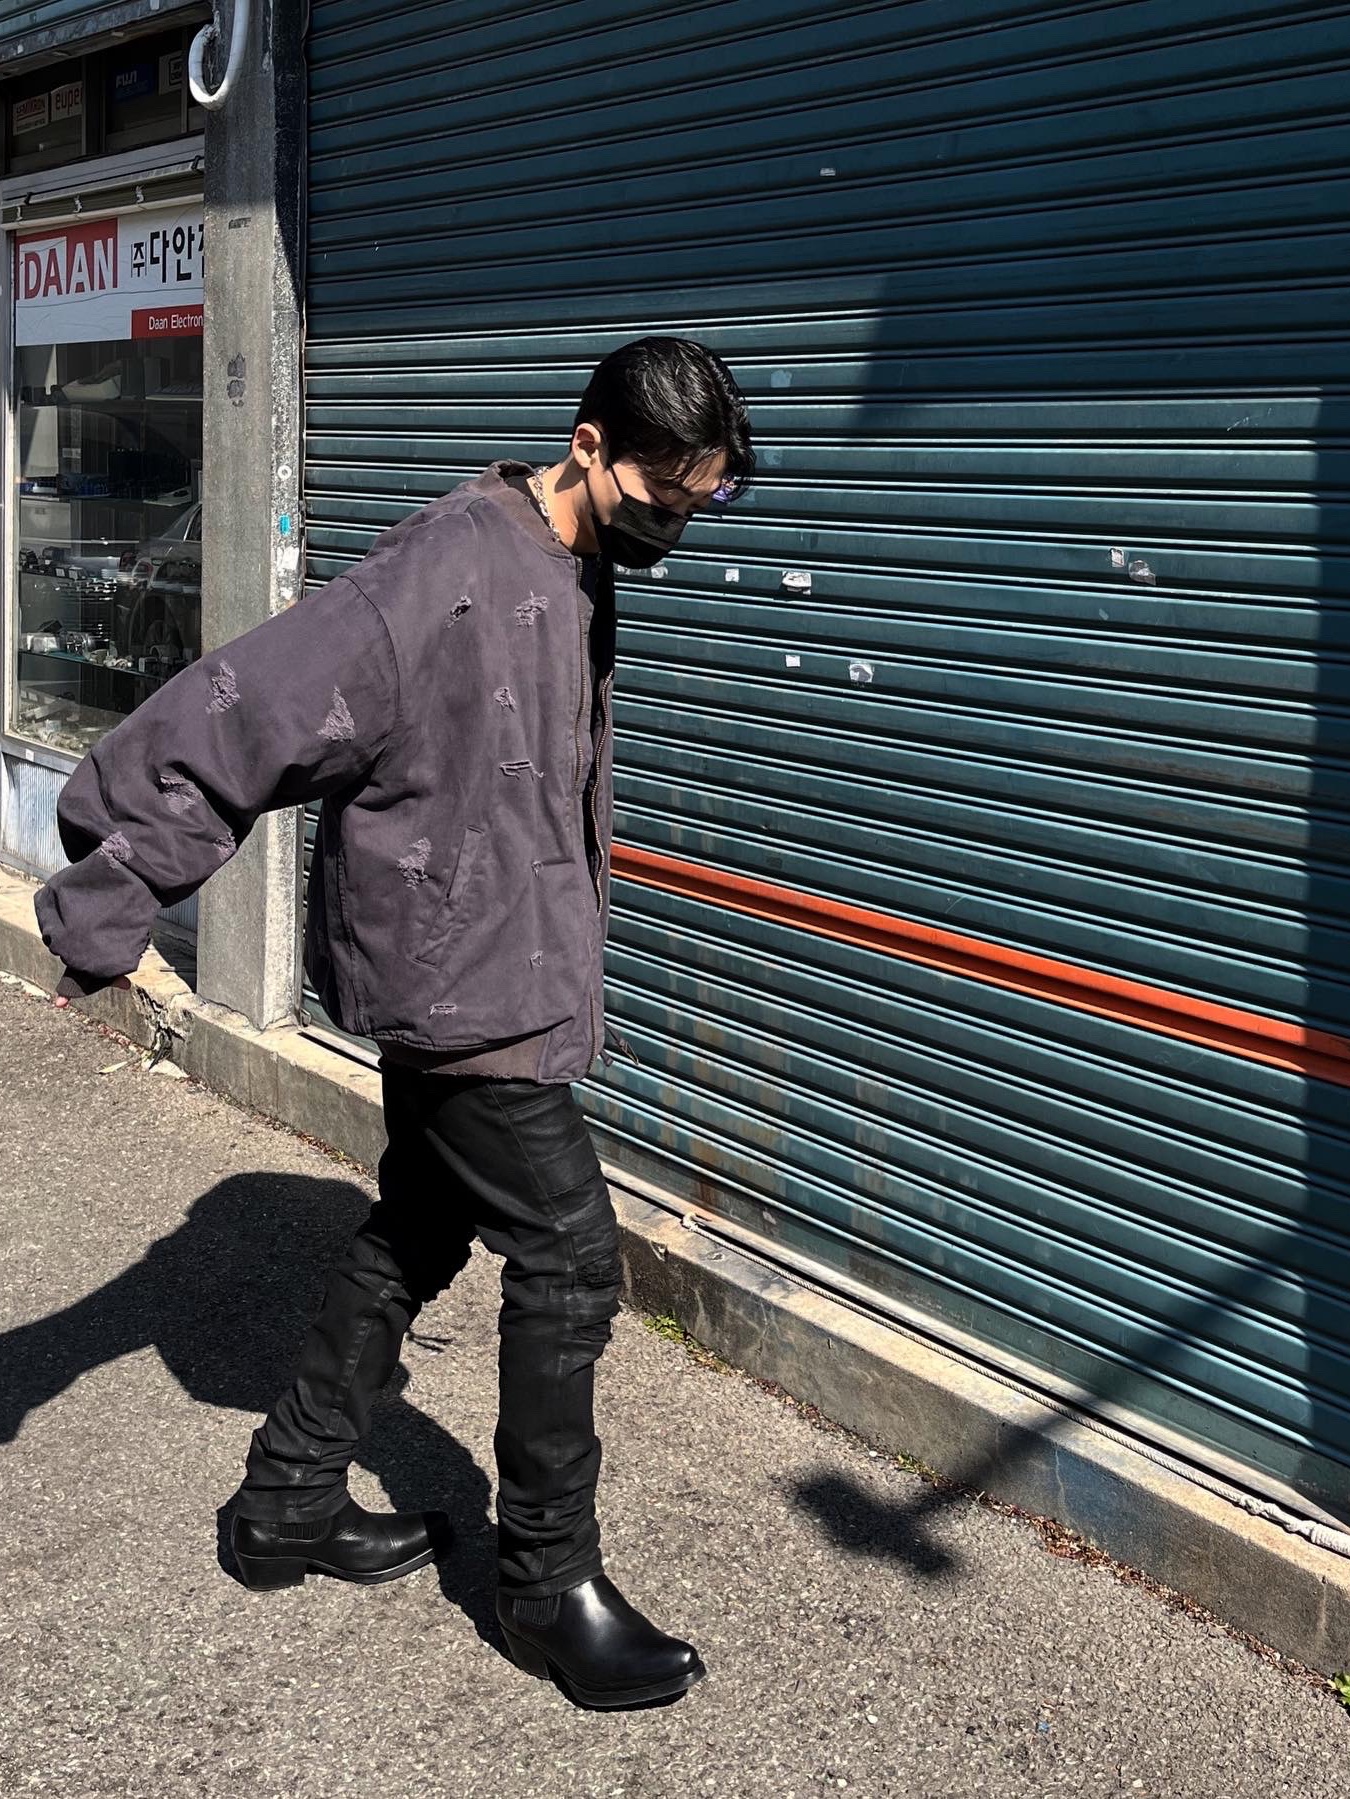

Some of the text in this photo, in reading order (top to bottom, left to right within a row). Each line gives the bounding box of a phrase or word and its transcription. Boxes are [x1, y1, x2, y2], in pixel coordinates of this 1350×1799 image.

[55, 87, 83, 115] eupe
[24, 237, 115, 300] DAAN
[148, 316, 169, 330] Daan
